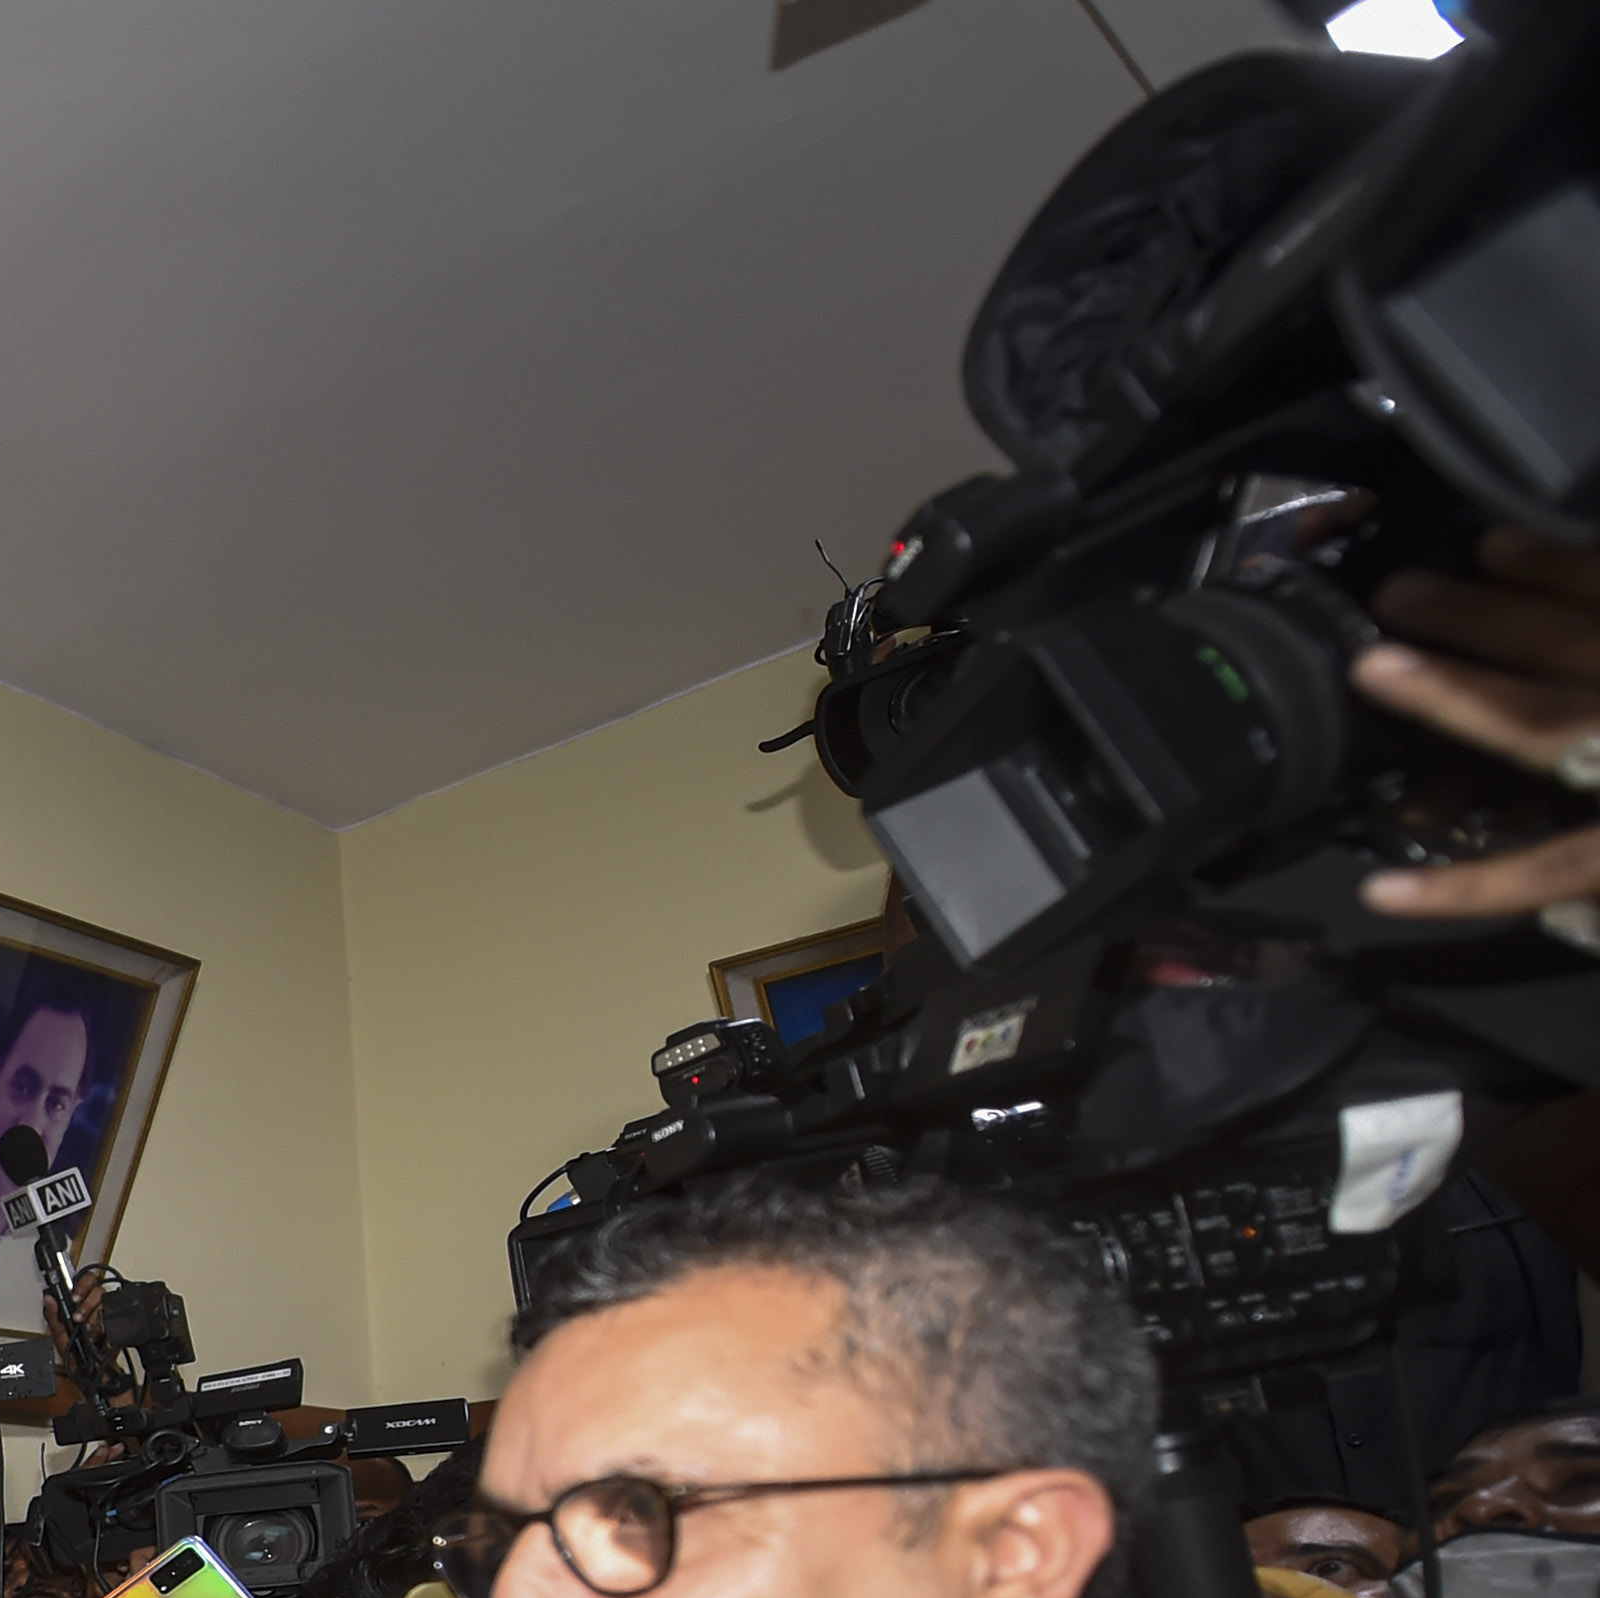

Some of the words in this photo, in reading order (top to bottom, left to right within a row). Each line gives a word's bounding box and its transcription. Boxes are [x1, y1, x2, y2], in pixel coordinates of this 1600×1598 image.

[652, 1119, 684, 1143] SONY
[44, 1176, 83, 1214] ANI
[8, 1195, 36, 1228] ANI
[0, 1362, 26, 1376] 4K
[385, 1417, 437, 1430] XDCAM
